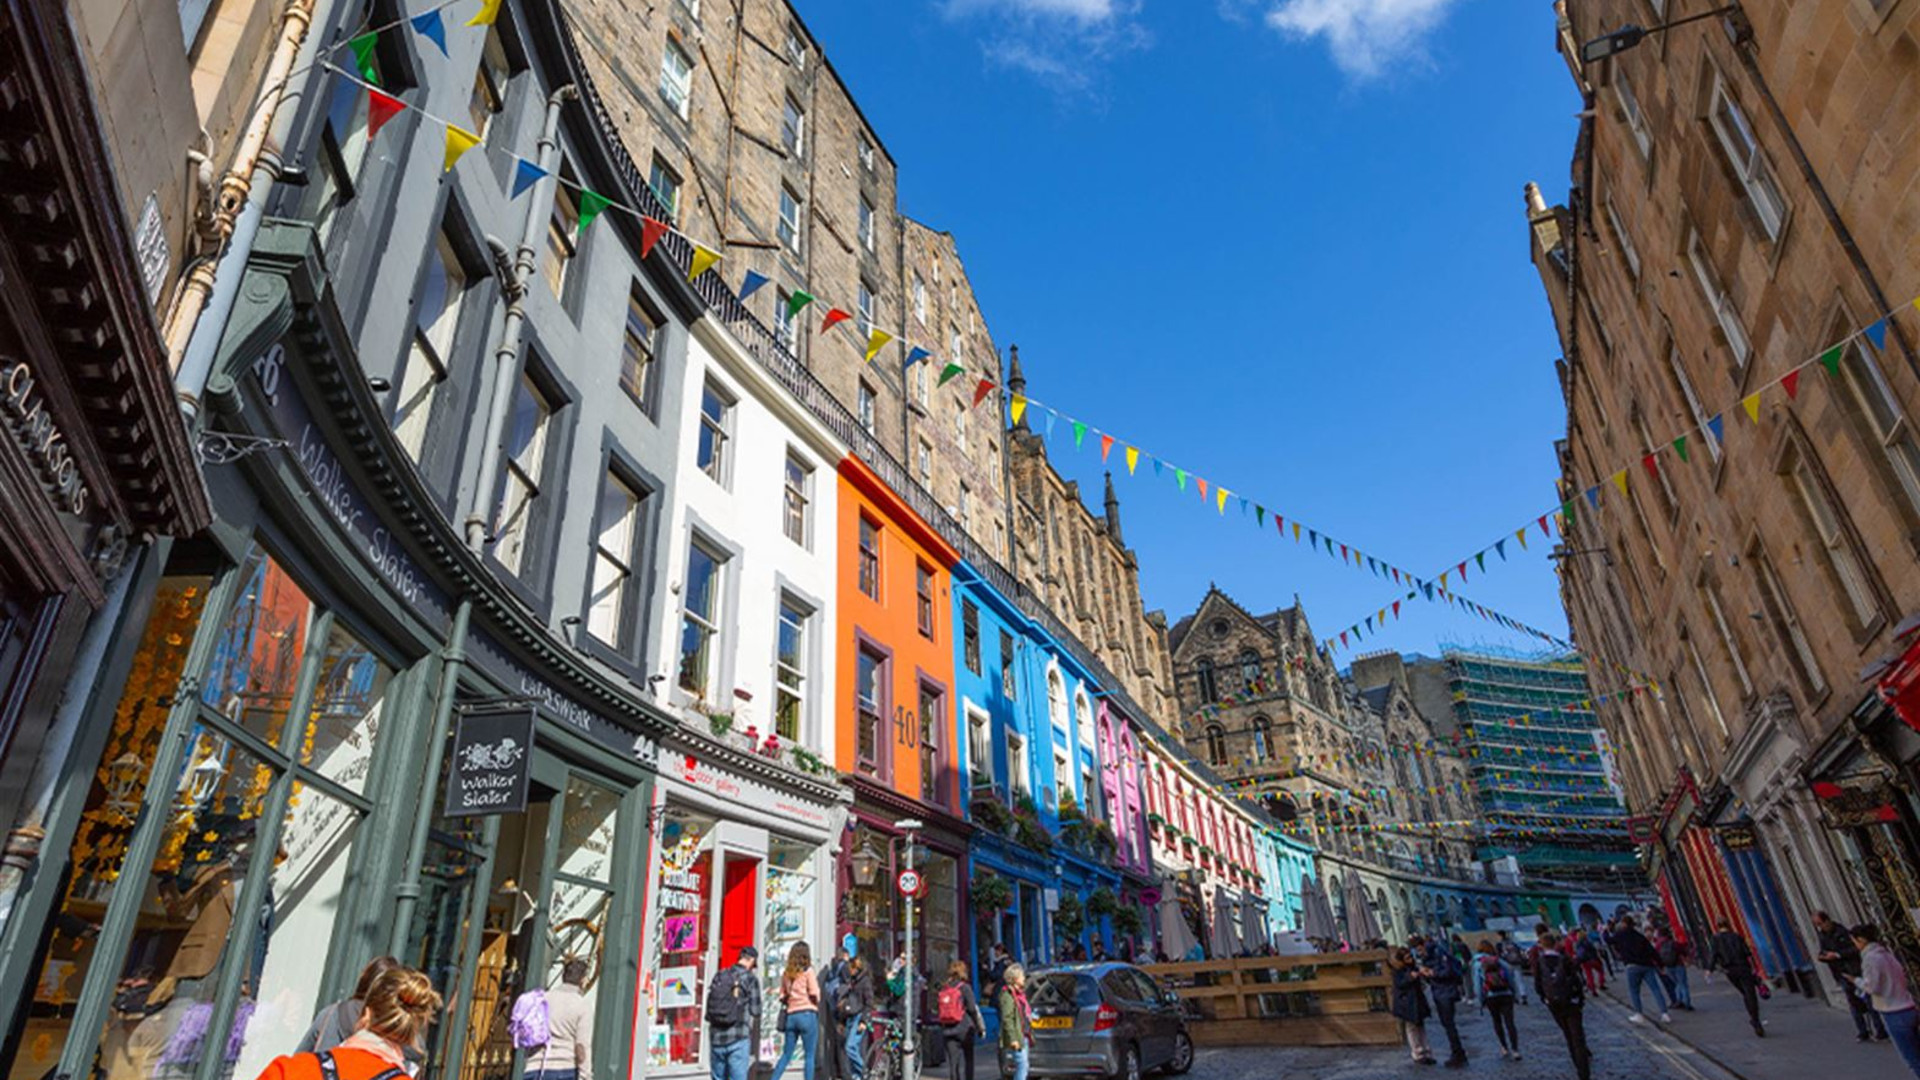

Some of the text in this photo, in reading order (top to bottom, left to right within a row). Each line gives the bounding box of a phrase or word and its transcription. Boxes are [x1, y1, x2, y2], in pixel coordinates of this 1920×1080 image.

[9, 363, 88, 514] CLARKSONS
[299, 422, 425, 604] Walker Slater
[892, 705, 915, 749] 40
[902, 875, 917, 890] 20
